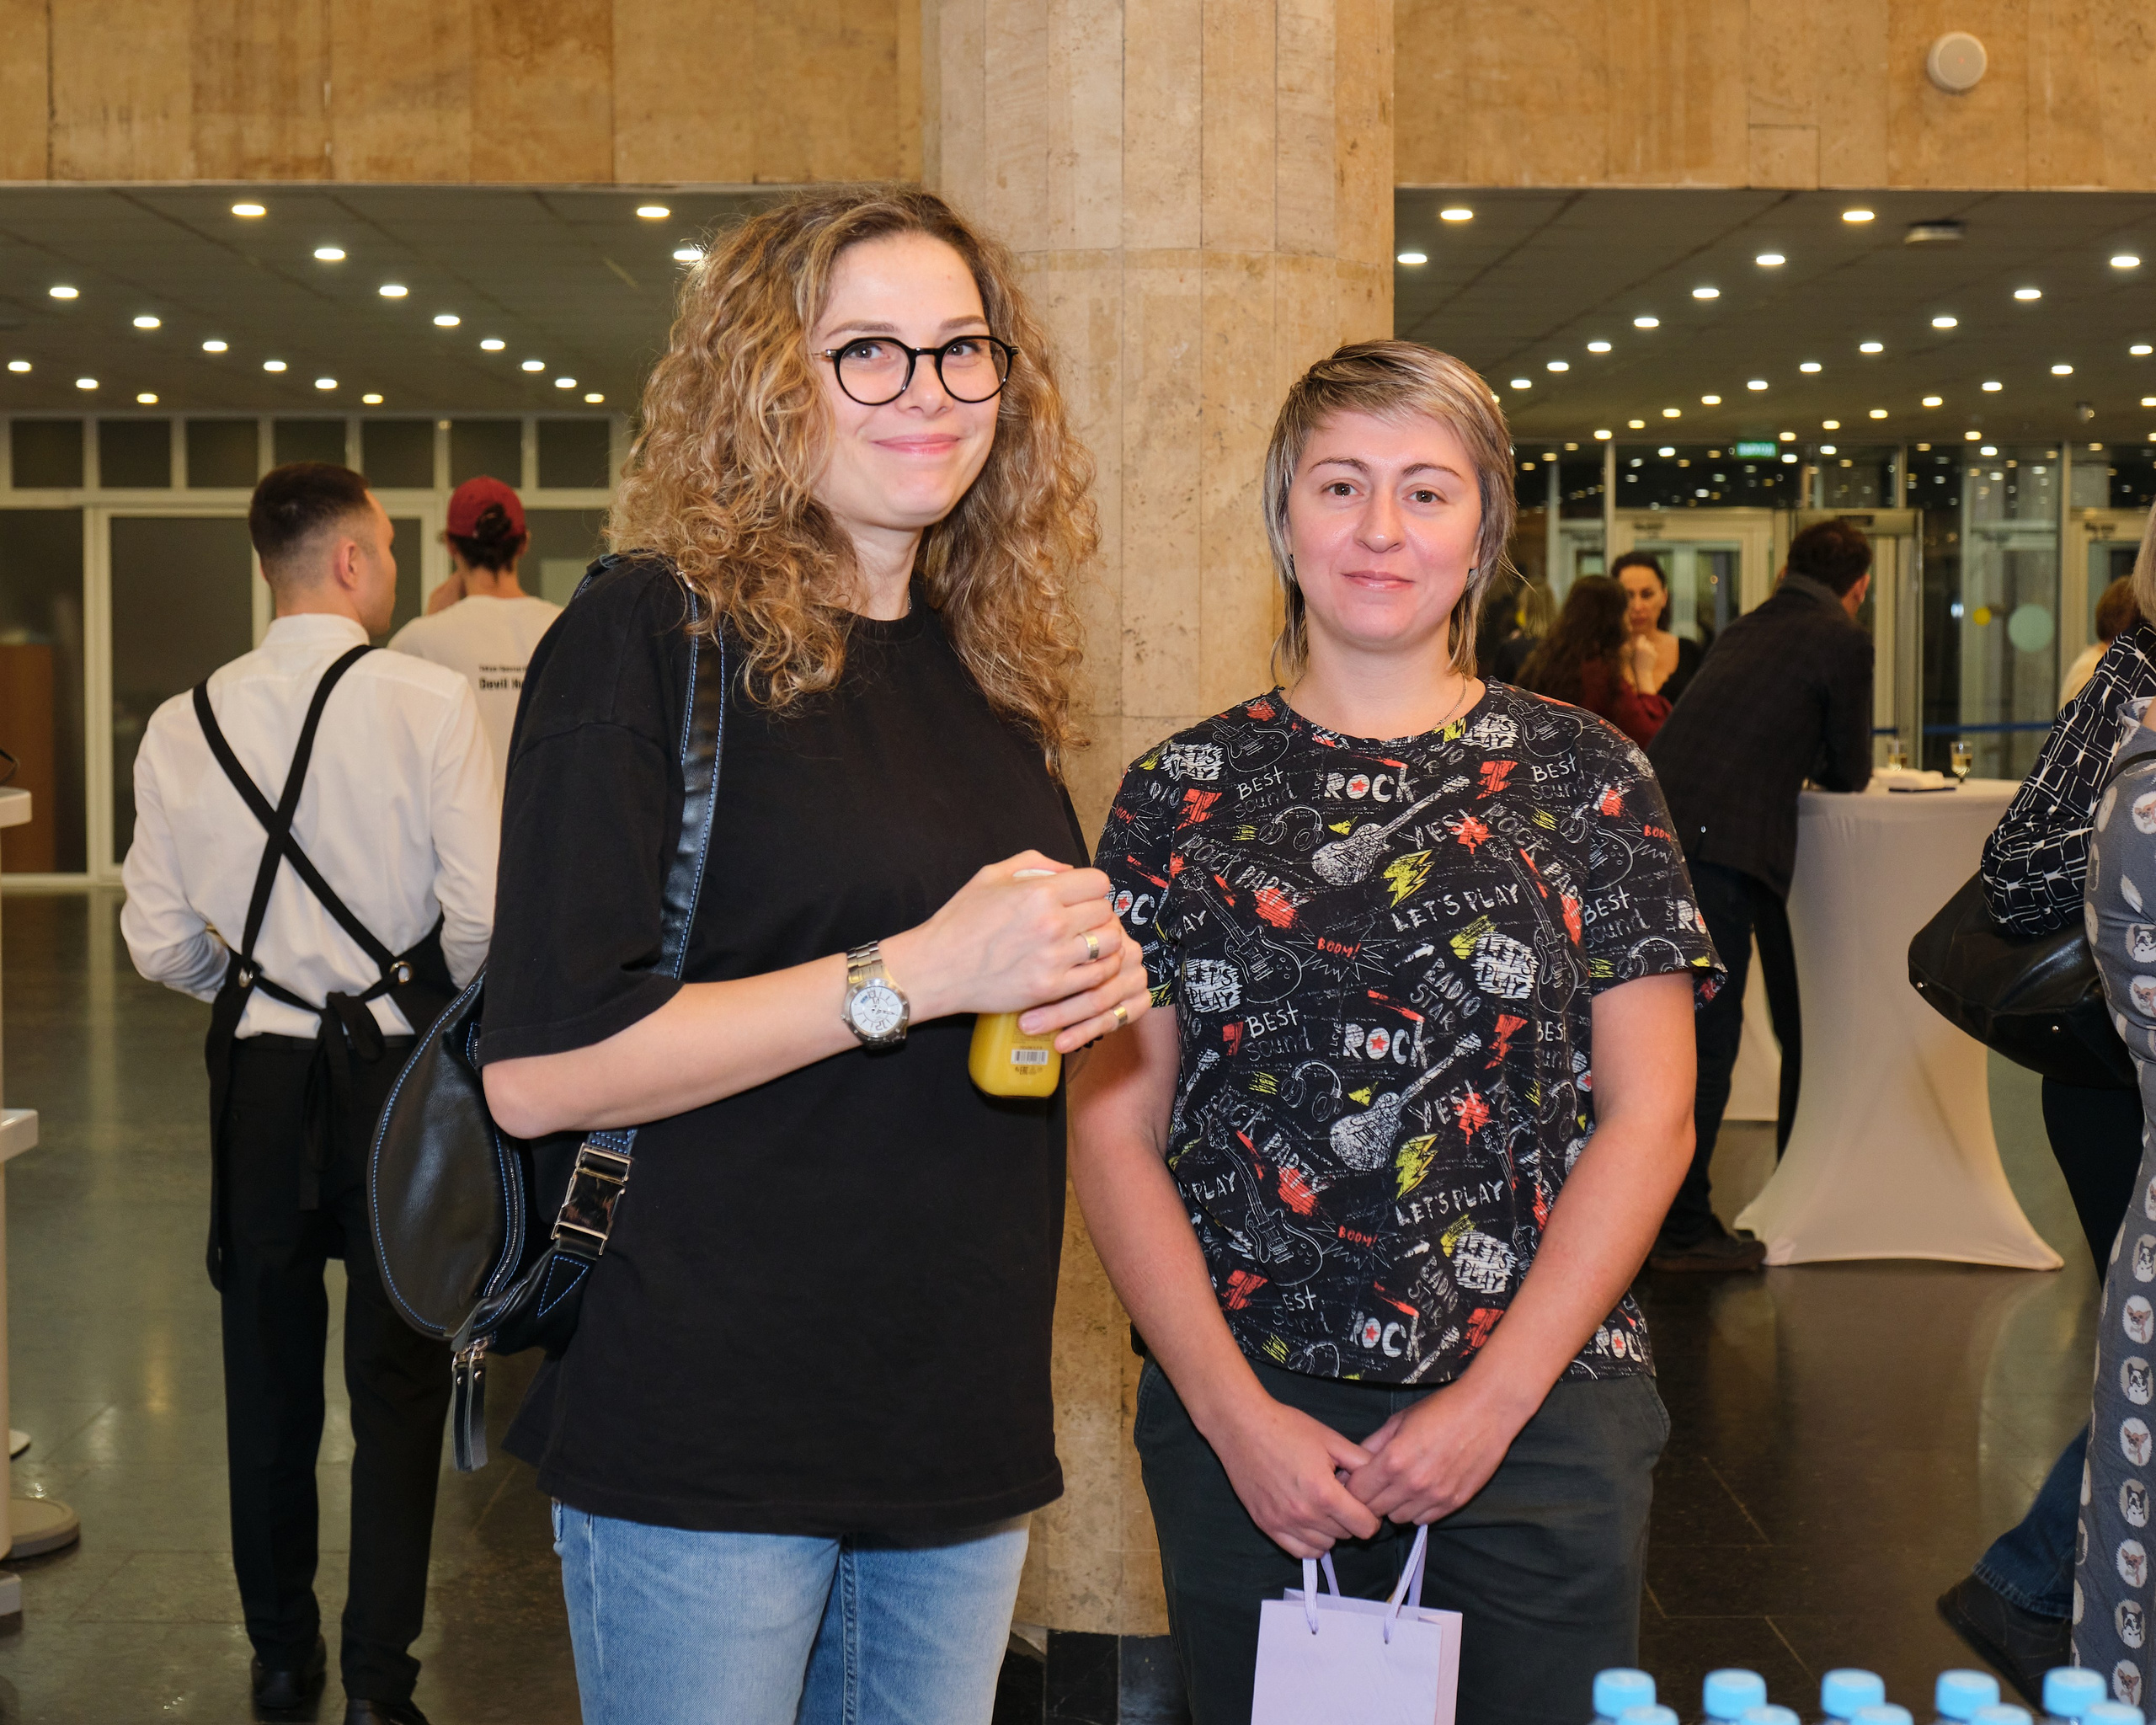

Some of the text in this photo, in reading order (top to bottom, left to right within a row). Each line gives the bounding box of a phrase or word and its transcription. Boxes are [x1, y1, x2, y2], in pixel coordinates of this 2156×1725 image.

[1323, 767, 1421, 804] ROCK
[1391, 883, 1519, 932] LET'S PLAY
[1316, 937, 1362, 960] BOOM!
[1188, 987, 1235, 1008] PLAY
[1342, 1017, 1435, 1070] ROCK
[1191, 1171, 1236, 1204] PLAY
[1395, 1191, 1450, 1226] LET'S
[1451, 1179, 1505, 1212] PLAY
[1337, 1225, 1379, 1249] BOOM!
